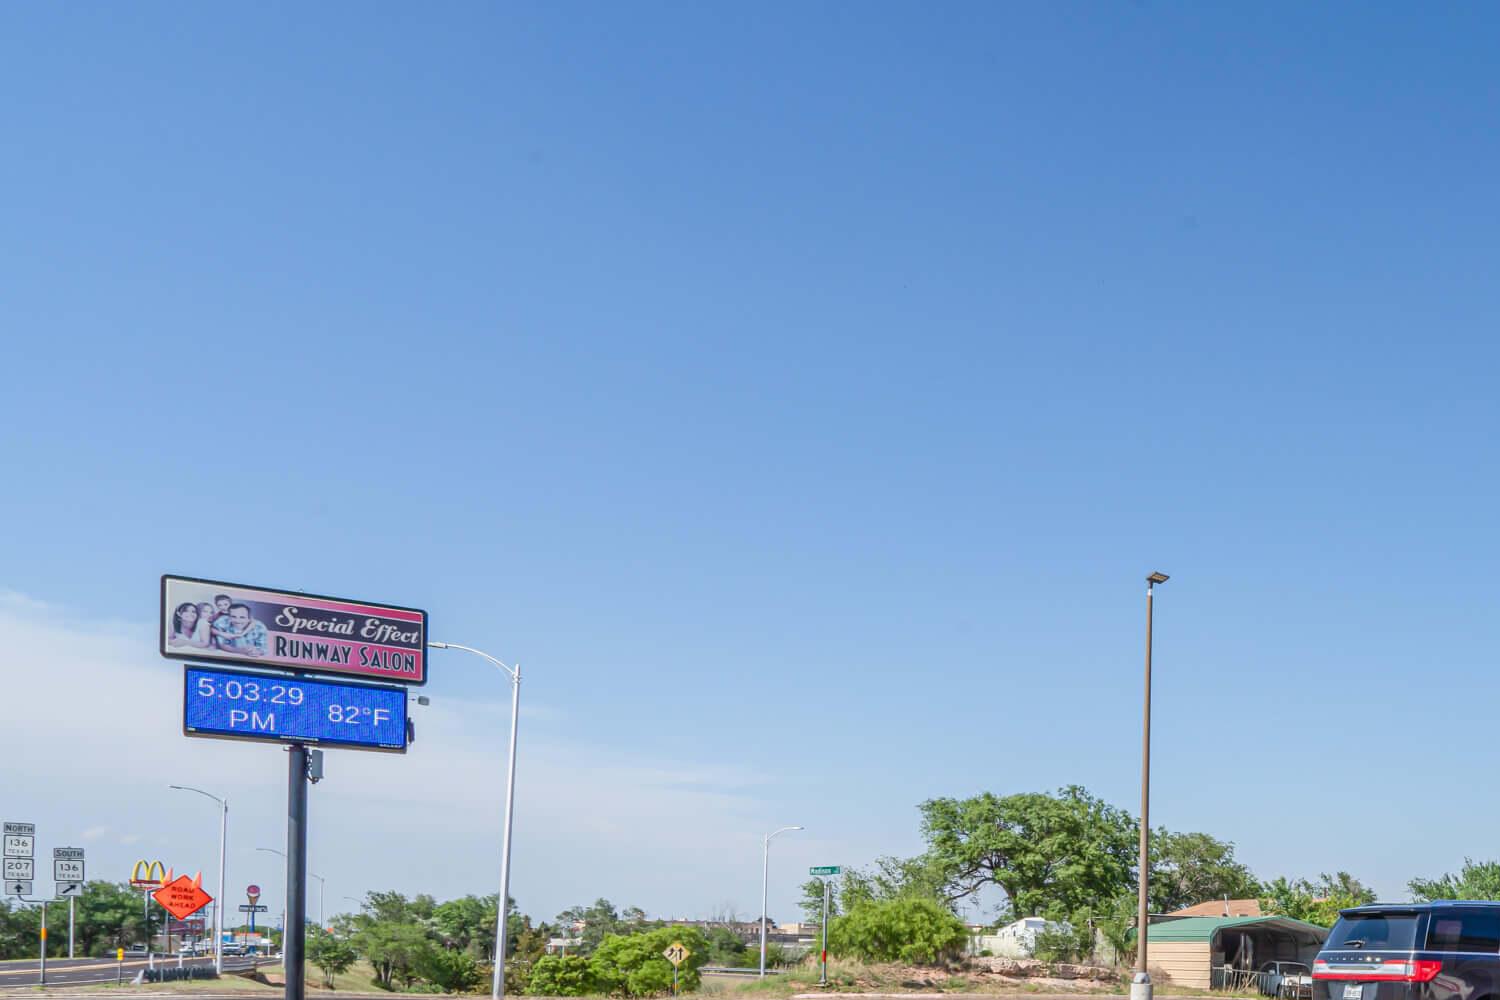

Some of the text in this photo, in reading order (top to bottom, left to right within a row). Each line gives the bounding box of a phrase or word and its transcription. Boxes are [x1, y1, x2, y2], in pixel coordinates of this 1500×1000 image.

[275, 606, 419, 644] Special Effect
[274, 635, 416, 673] RUNWAY SALON
[198, 677, 304, 705] 5:03:29
[229, 709, 275, 731] PM
[328, 704, 390, 726] 82°F
[5, 824, 33, 832] NORTH
[10, 838, 28, 847] 136
[56, 849, 83, 857] SOUTH
[7, 862, 30, 870] 207
[60, 863, 79, 872] 136
